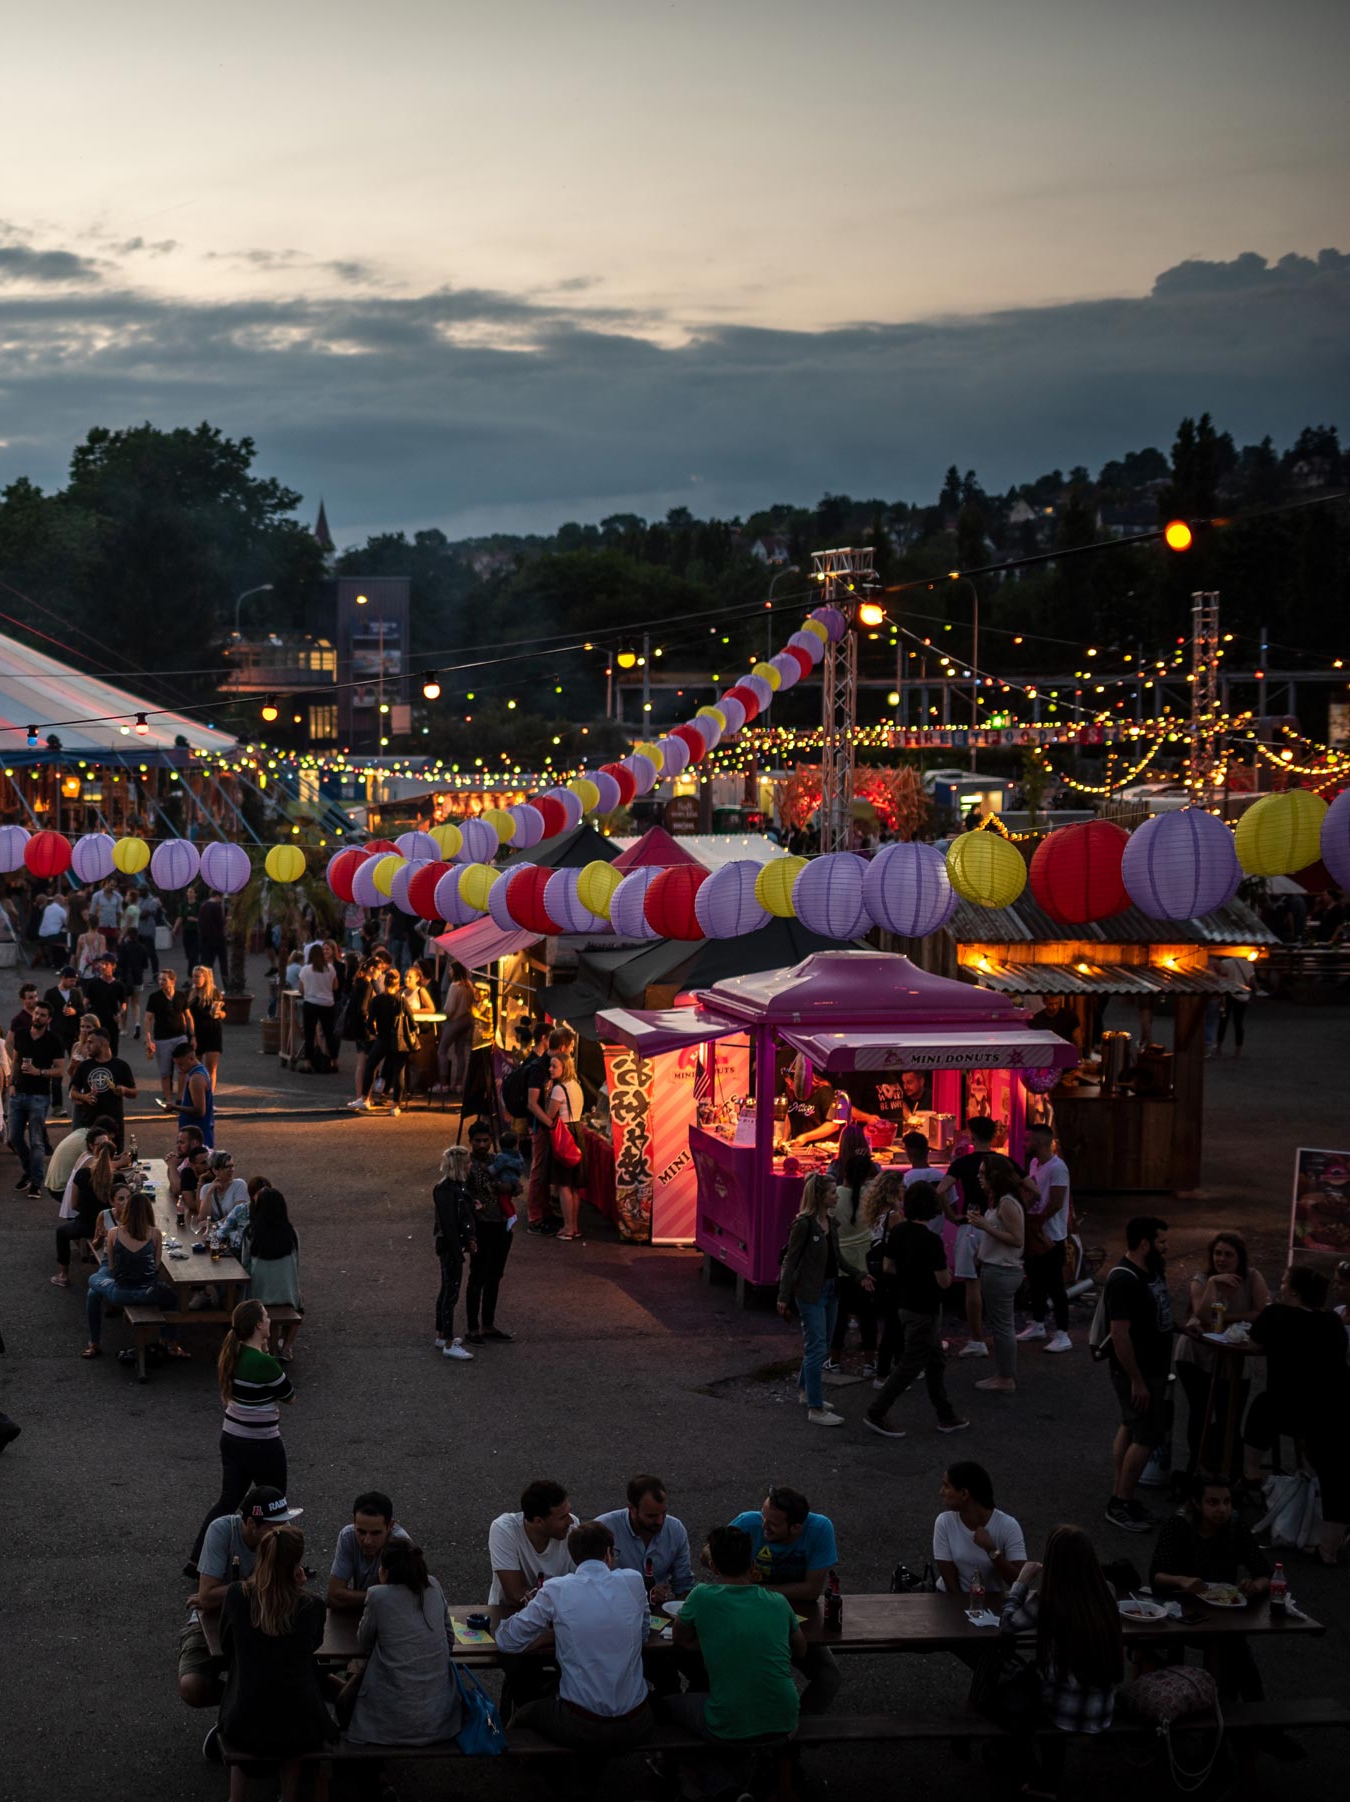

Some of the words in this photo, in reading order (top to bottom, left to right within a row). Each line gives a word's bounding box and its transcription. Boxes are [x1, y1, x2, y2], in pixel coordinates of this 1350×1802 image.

[910, 1055, 941, 1064] MINI
[945, 1053, 1000, 1063] DONUTS
[657, 1150, 692, 1186] MINI
